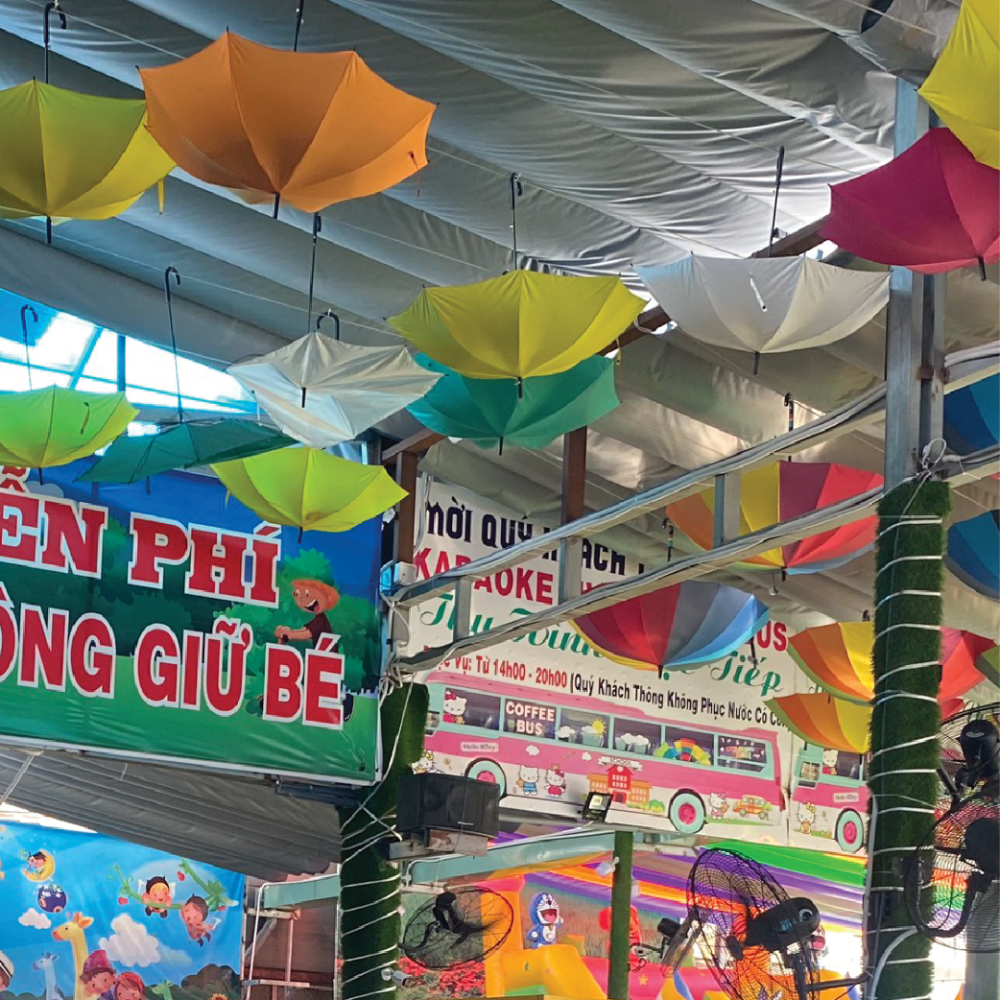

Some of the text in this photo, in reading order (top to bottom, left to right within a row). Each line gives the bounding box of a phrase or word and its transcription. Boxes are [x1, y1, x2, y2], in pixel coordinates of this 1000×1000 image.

[128, 512, 282, 607] PHÍ
[135, 616, 254, 717] GIỮ
[263, 634, 346, 730] BÉ
[475, 651, 491, 675] Từ
[494, 659, 526, 681] 14h00
[536, 667, 567, 688] 20h00
[570, 672, 594, 696] (Quý
[598, 677, 630, 699] Khách
[667, 690, 698, 714] Không
[700, 697, 725, 720] Phục
[755, 706, 767, 724] Có
[505, 701, 555, 722] COFFEE
[516, 719, 543, 735] BUS
